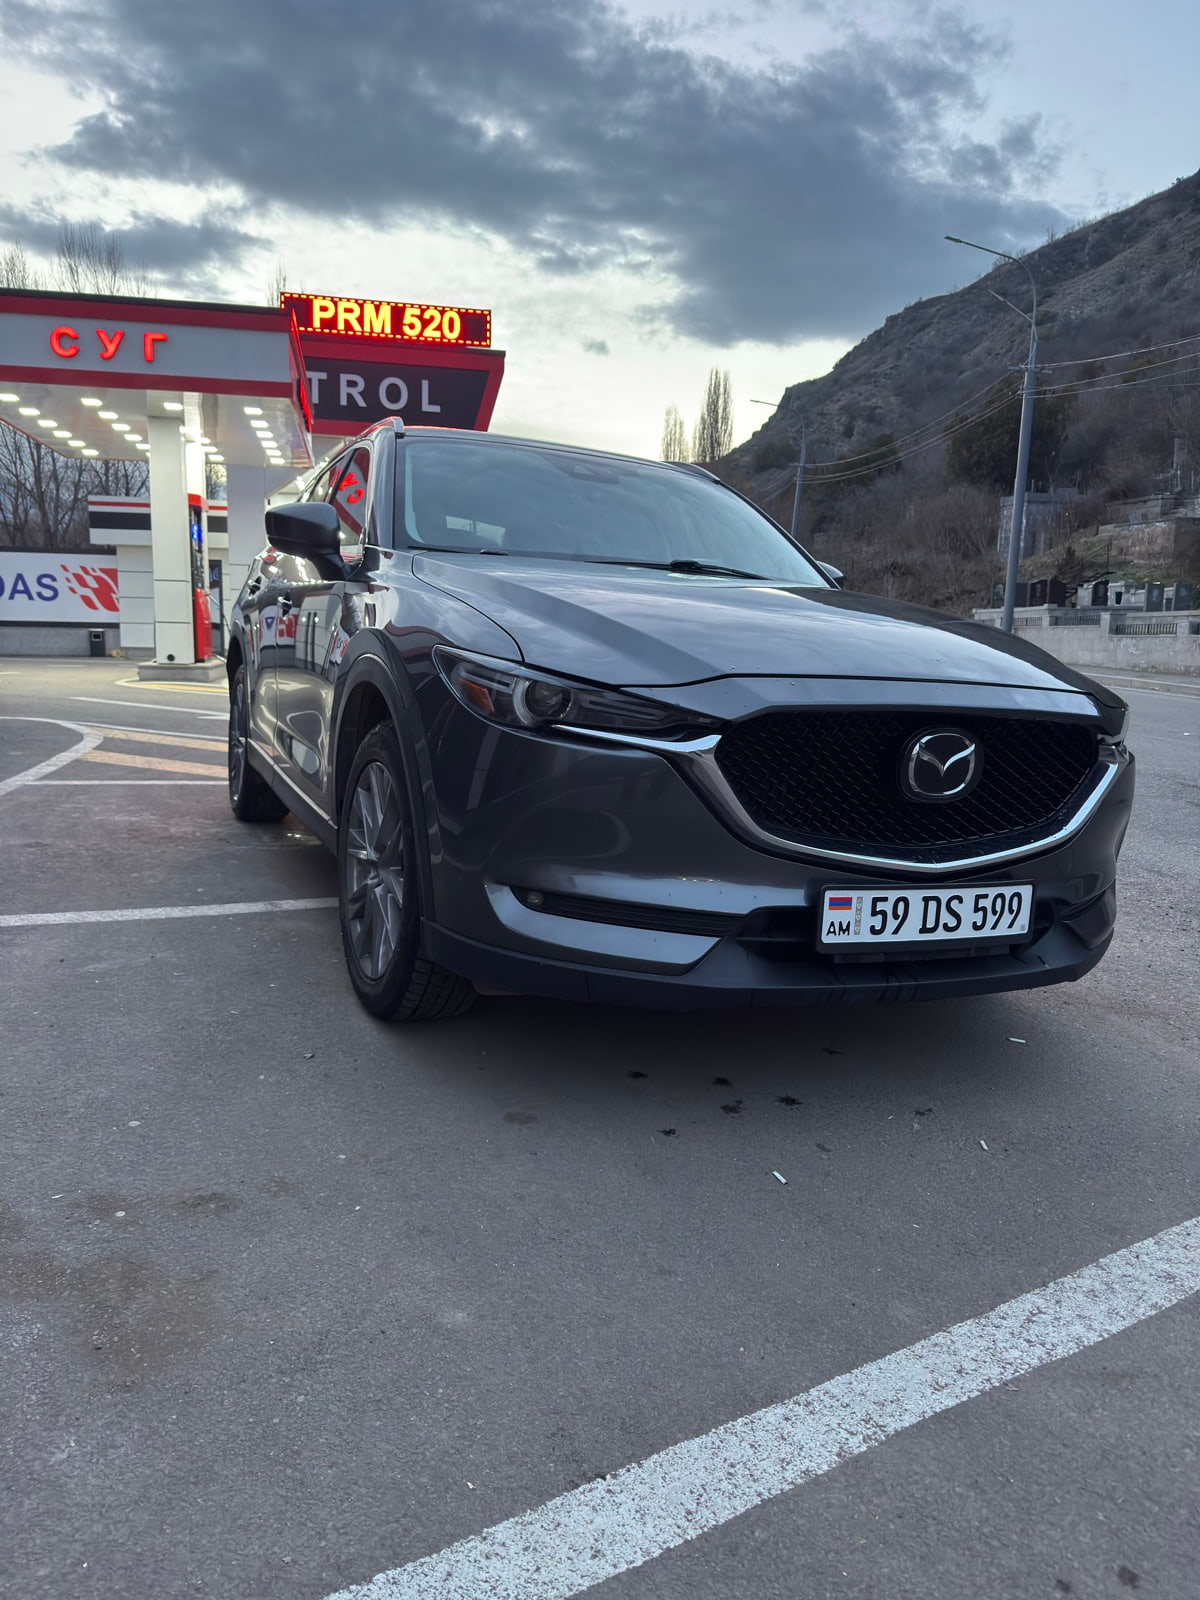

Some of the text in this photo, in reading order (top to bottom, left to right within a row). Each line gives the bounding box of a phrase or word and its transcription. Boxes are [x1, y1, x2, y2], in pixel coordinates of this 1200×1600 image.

[312, 299, 461, 340] PRM 520
[50, 326, 167, 362] СУГ
[0, 572, 59, 602] AS
[826, 920, 851, 937] AM
[870, 896, 910, 936] 59
[919, 894, 964, 934] DS
[972, 891, 1023, 932] 599
